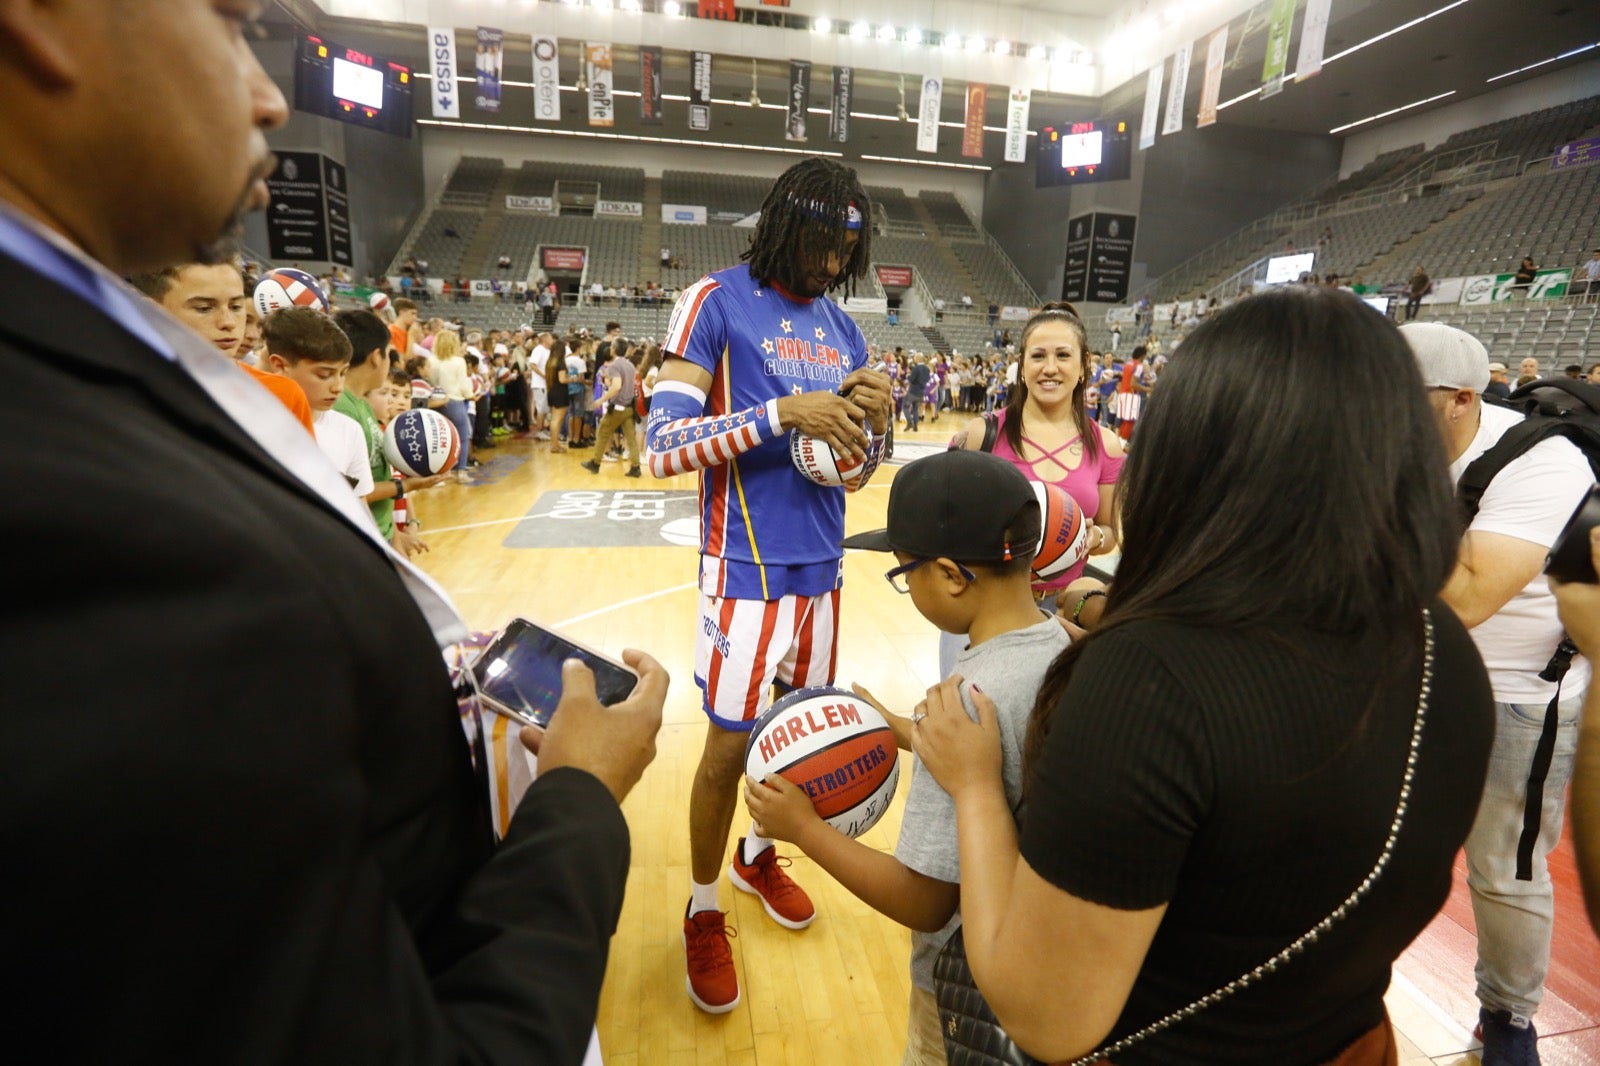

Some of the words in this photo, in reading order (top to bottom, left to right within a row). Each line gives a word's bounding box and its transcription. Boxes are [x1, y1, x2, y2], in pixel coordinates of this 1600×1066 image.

[434, 34, 452, 93] asisa
[539, 66, 555, 117] otero
[601, 202, 640, 214] IDEAL
[775, 336, 841, 369] HARLEM
[801, 437, 828, 483] HARLEM
[758, 703, 863, 765] HARLEM
